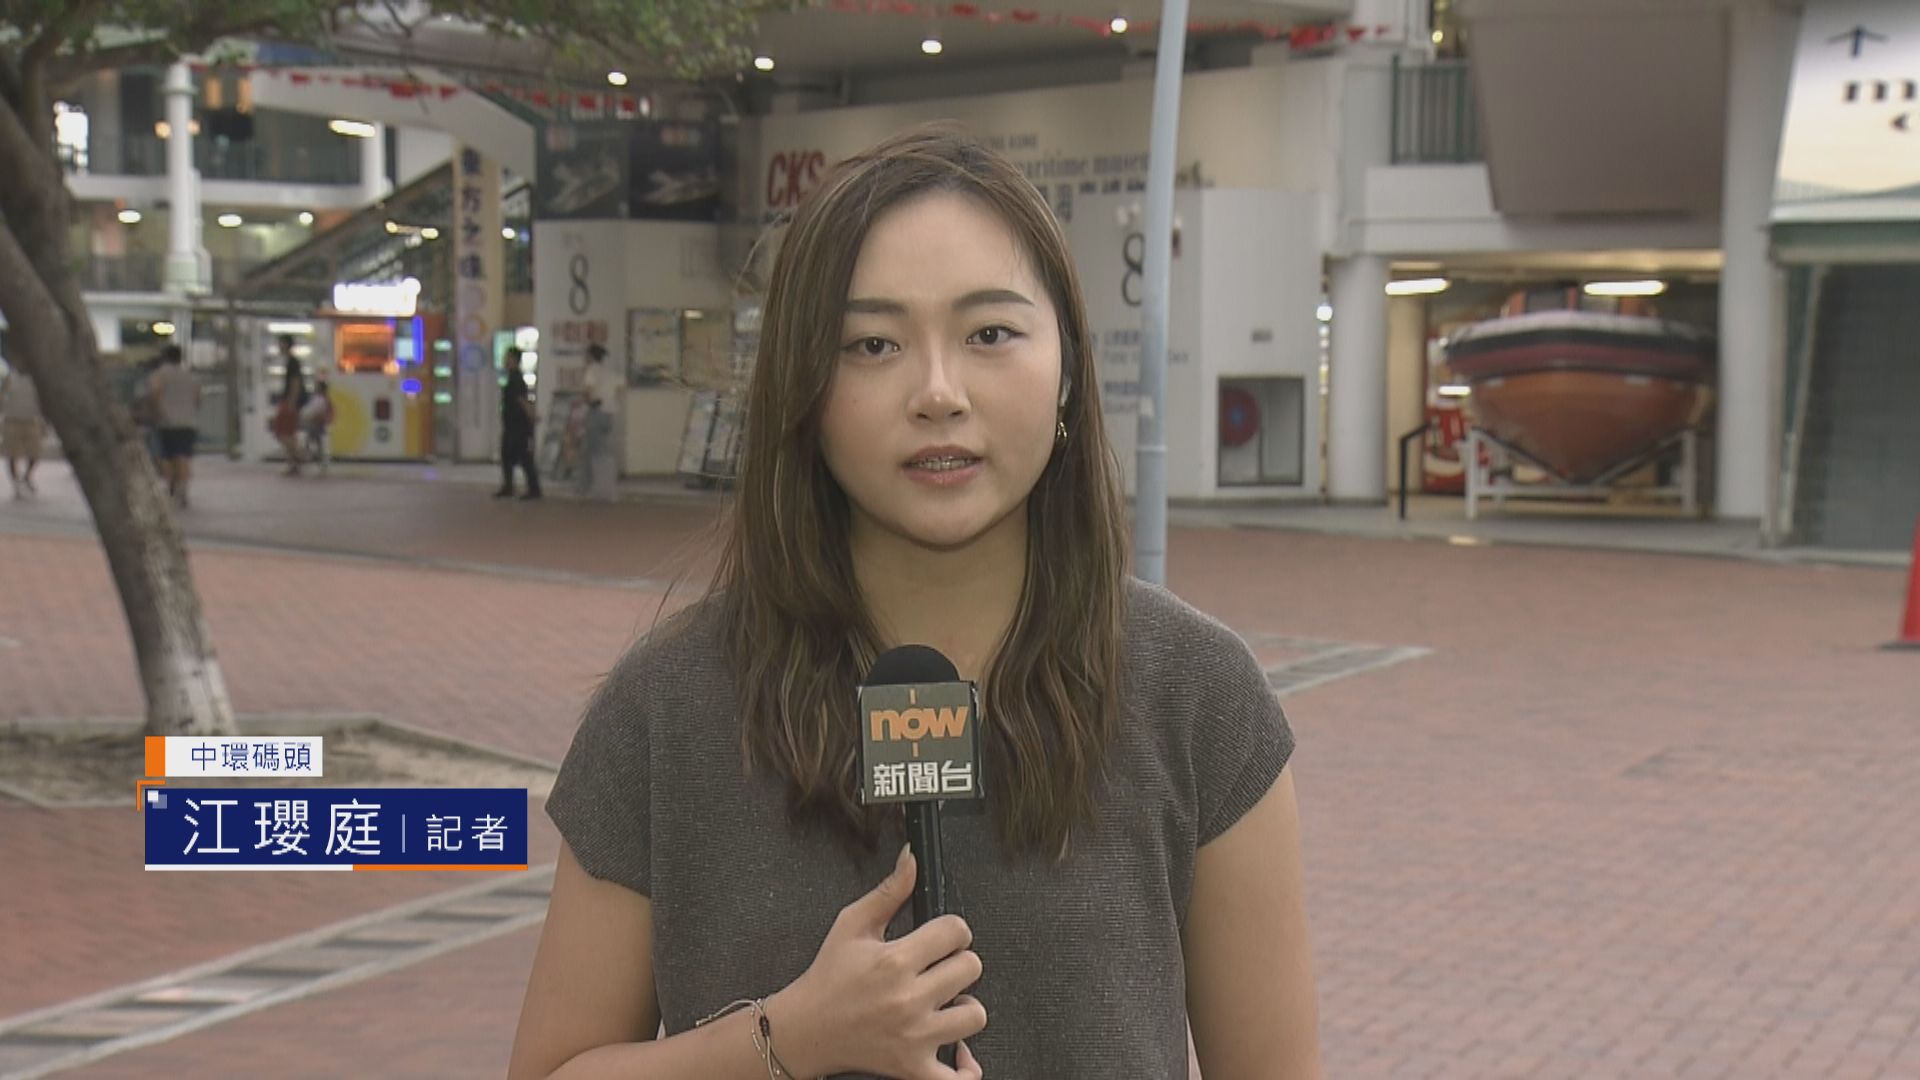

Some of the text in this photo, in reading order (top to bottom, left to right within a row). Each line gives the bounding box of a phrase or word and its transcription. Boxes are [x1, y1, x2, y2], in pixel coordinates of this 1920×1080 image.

[568, 253, 591, 316] 8
[870, 706, 968, 741] now
[873, 760, 972, 797] 新聞台
